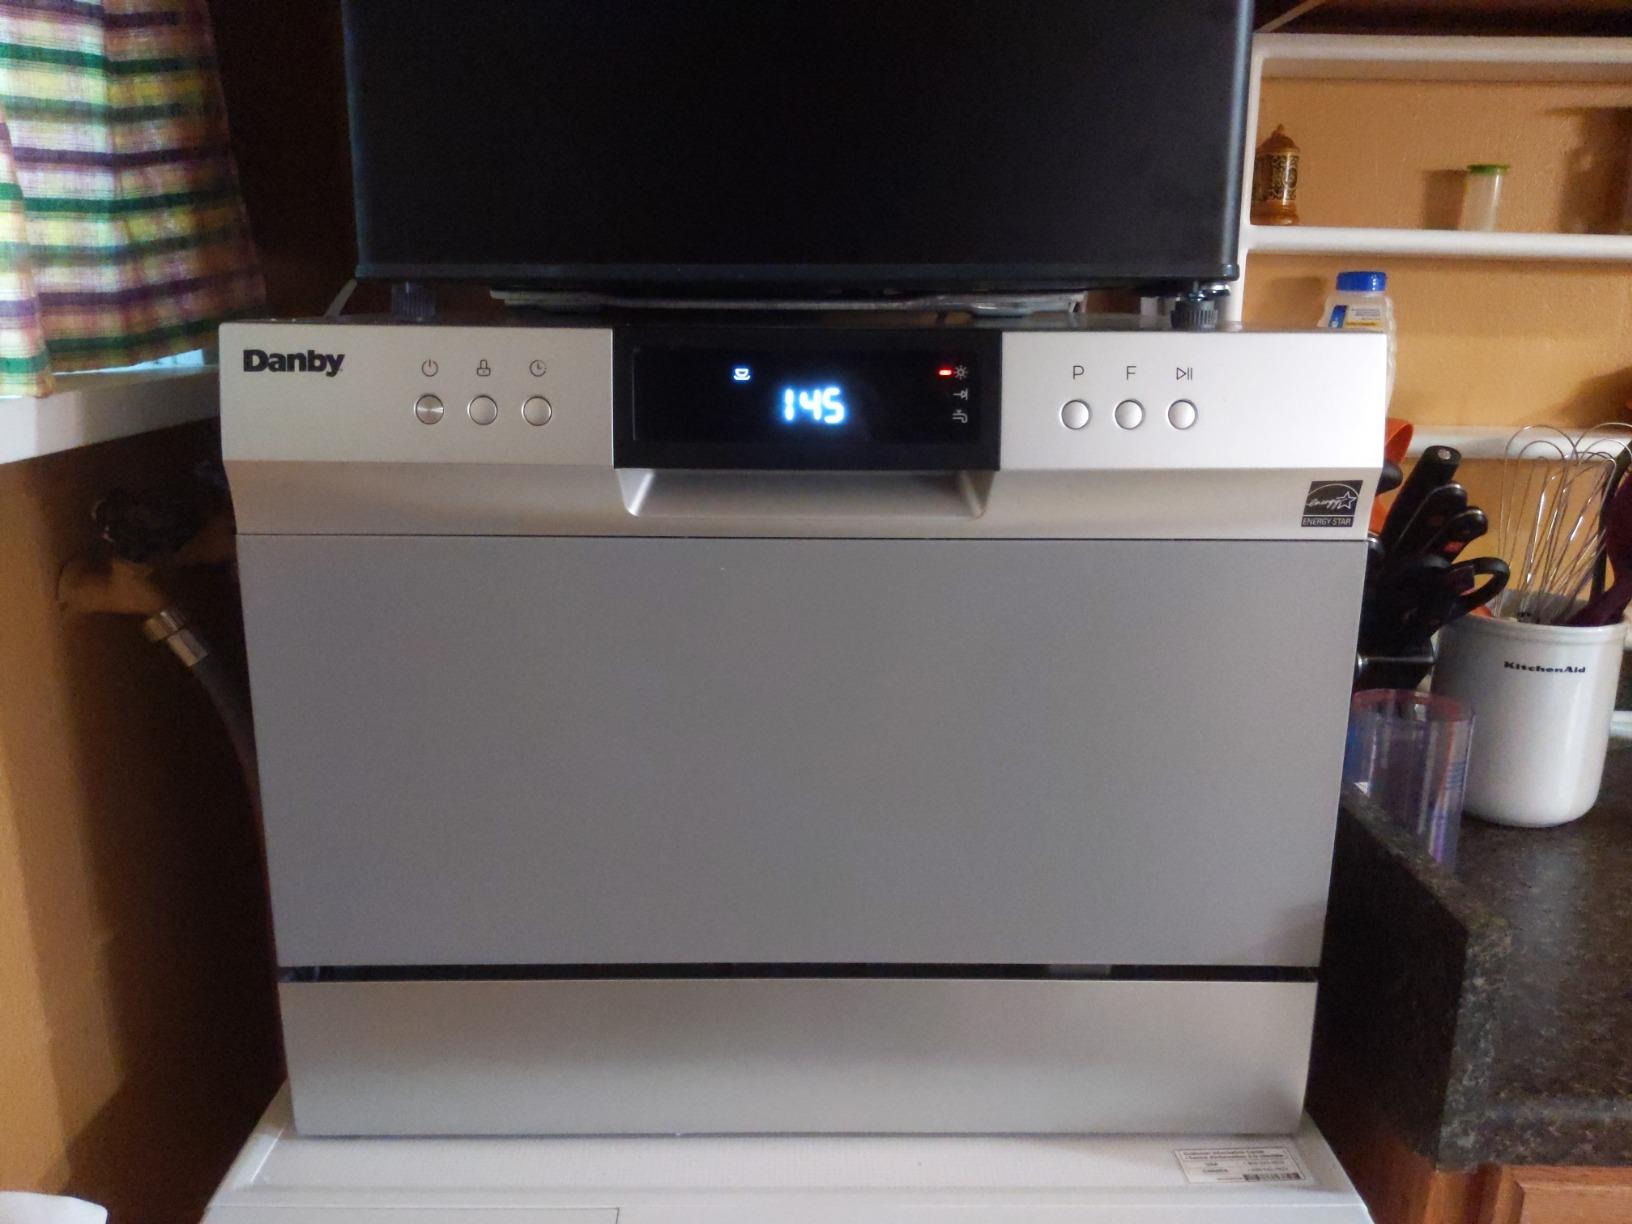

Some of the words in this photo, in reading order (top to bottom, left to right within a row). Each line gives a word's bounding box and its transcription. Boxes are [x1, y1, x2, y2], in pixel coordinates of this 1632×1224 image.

[243, 349, 344, 377] Danby
[1072, 365, 1084, 380] P
[1126, 366, 1137, 380] F
[782, 386, 845, 425] 145
[1302, 517, 1331, 526] ENERGY
[1332, 517, 1352, 526] STAR
[1503, 660, 1586, 673] KitchenAid
